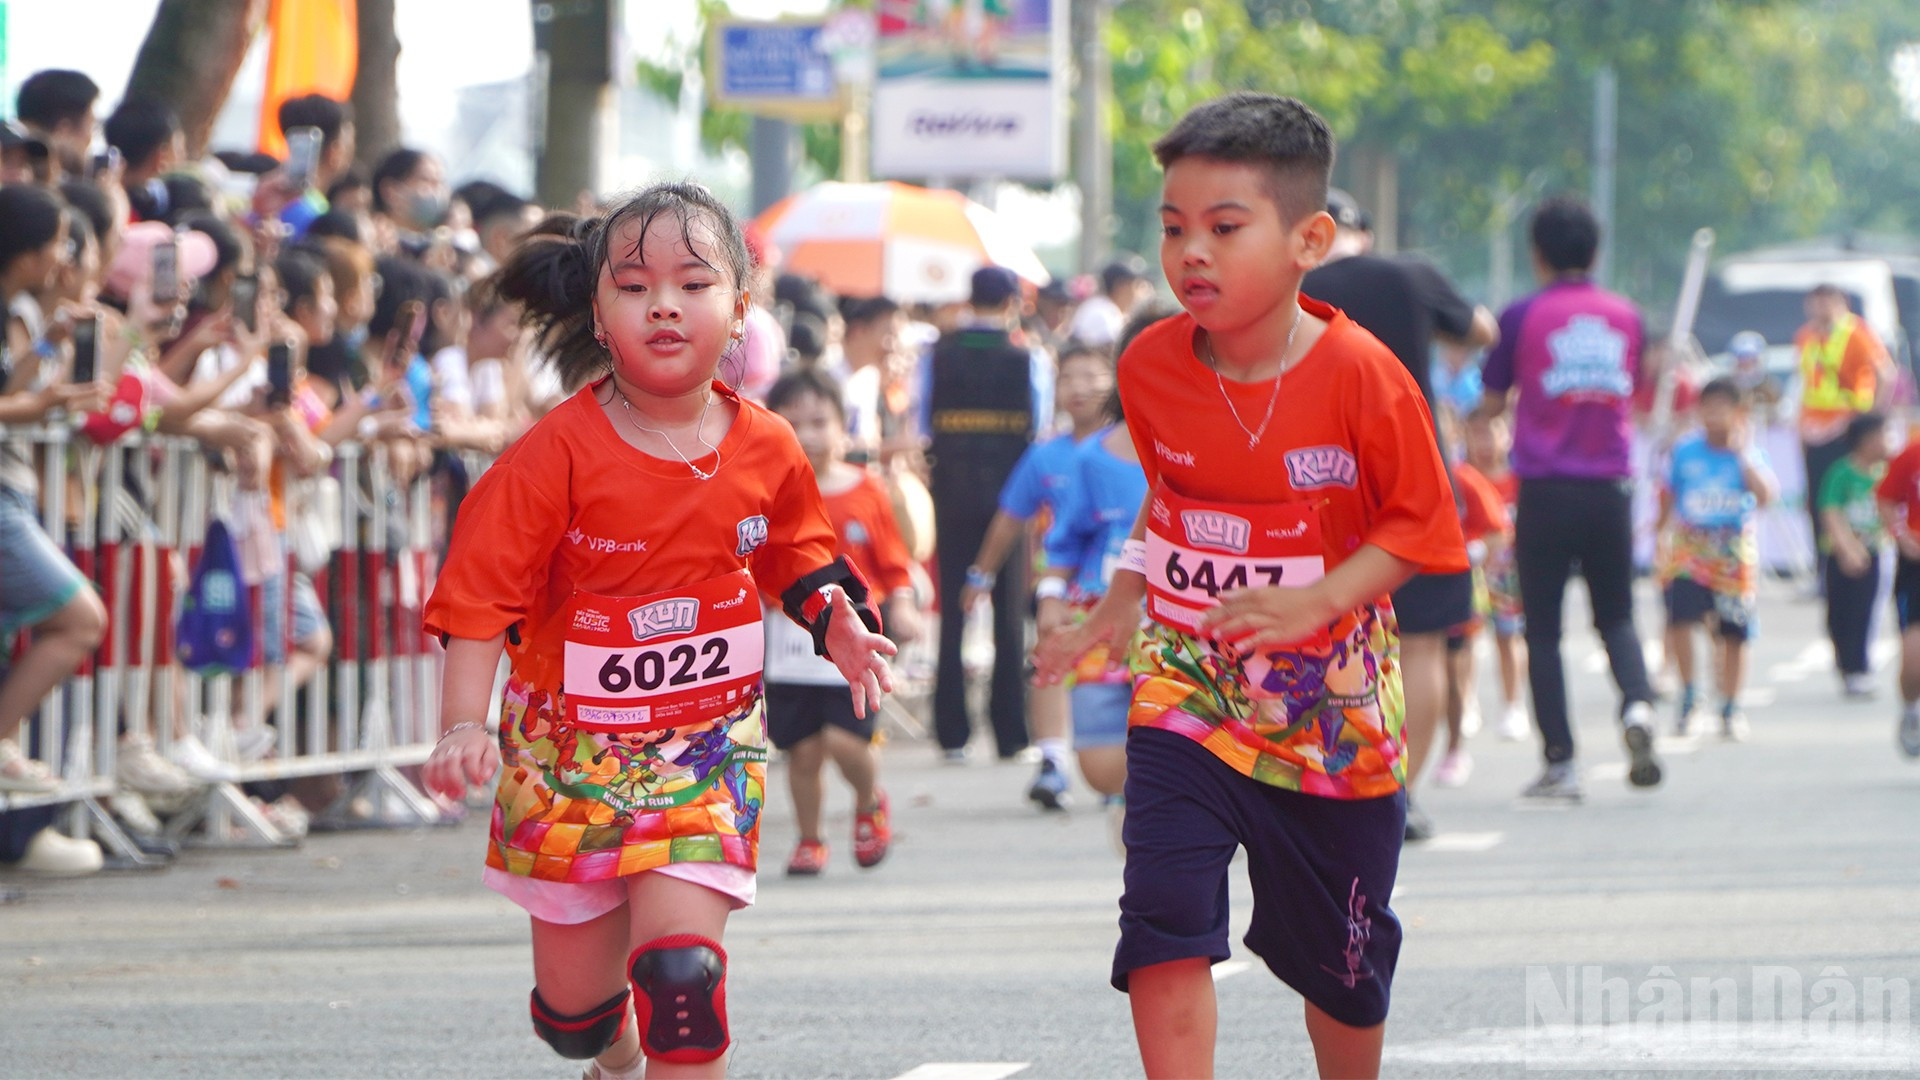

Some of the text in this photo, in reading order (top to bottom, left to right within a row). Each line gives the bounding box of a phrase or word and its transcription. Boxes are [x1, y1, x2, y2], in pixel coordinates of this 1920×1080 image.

[1154, 438, 1196, 468] VPBank
[1266, 528, 1301, 539] NEXUS
[587, 535, 647, 553] VPBank
[1166, 551, 1283, 597] 6447
[713, 597, 743, 610] NEXUS
[574, 615, 609, 628] MUSIC
[598, 637, 730, 693] 6022
[602, 791, 624, 810] KUN
[648, 796, 674, 806] RUN
